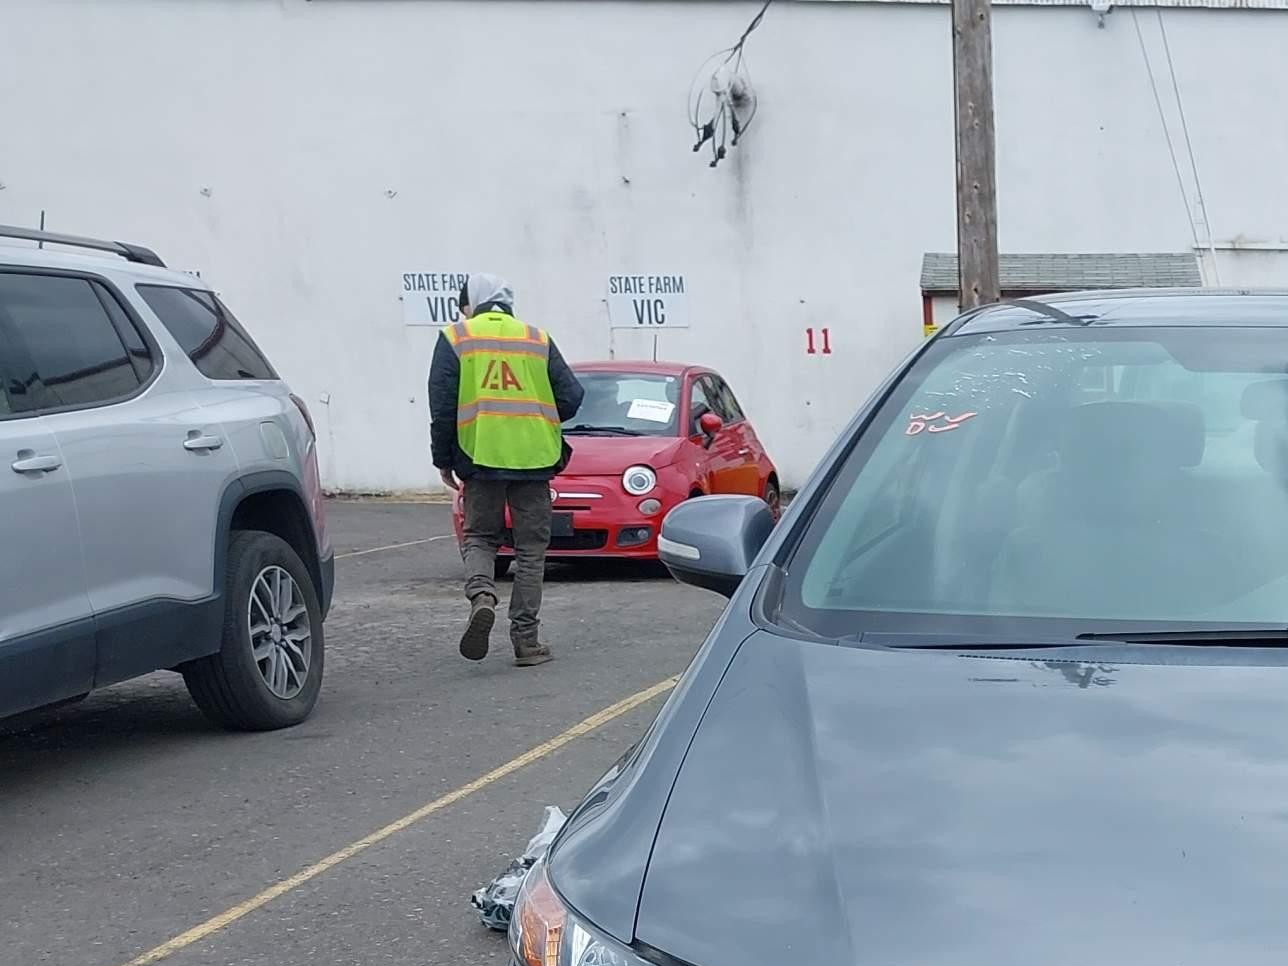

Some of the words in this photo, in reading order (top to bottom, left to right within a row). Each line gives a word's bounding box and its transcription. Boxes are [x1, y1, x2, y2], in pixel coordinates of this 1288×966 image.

[403, 273, 439, 291] STATE
[441, 273, 468, 291] FAR
[609, 276, 645, 294] STATE
[648, 276, 684, 293] FARM
[427, 296, 460, 322] VIC
[633, 299, 665, 324] VIC
[806, 328, 832, 354] 11
